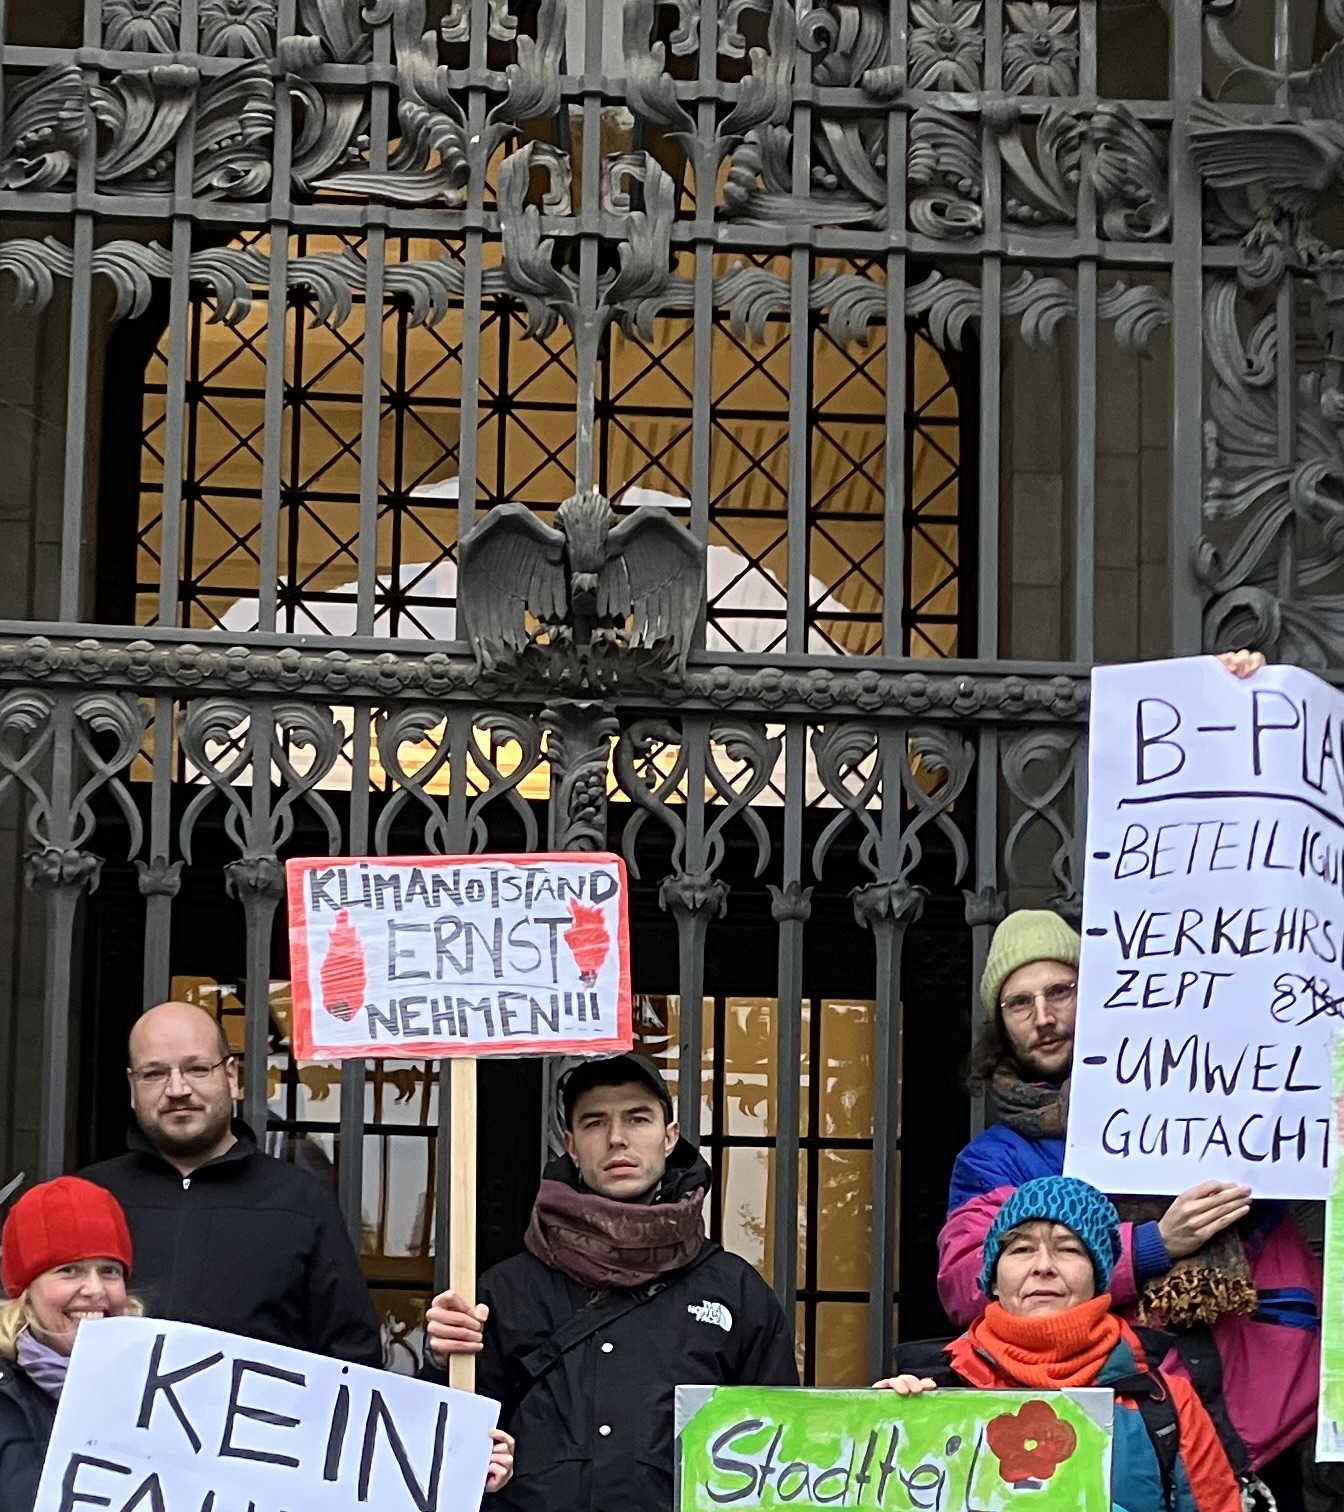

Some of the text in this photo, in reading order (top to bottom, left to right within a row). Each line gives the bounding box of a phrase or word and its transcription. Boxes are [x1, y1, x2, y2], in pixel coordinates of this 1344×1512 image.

[387, 915, 574, 983] ERNST
[364, 990, 604, 1039] NEHMEN!!!
[1103, 970, 1236, 1009] ZEPT
[1083, 1034, 1328, 1096] -UMWEL
